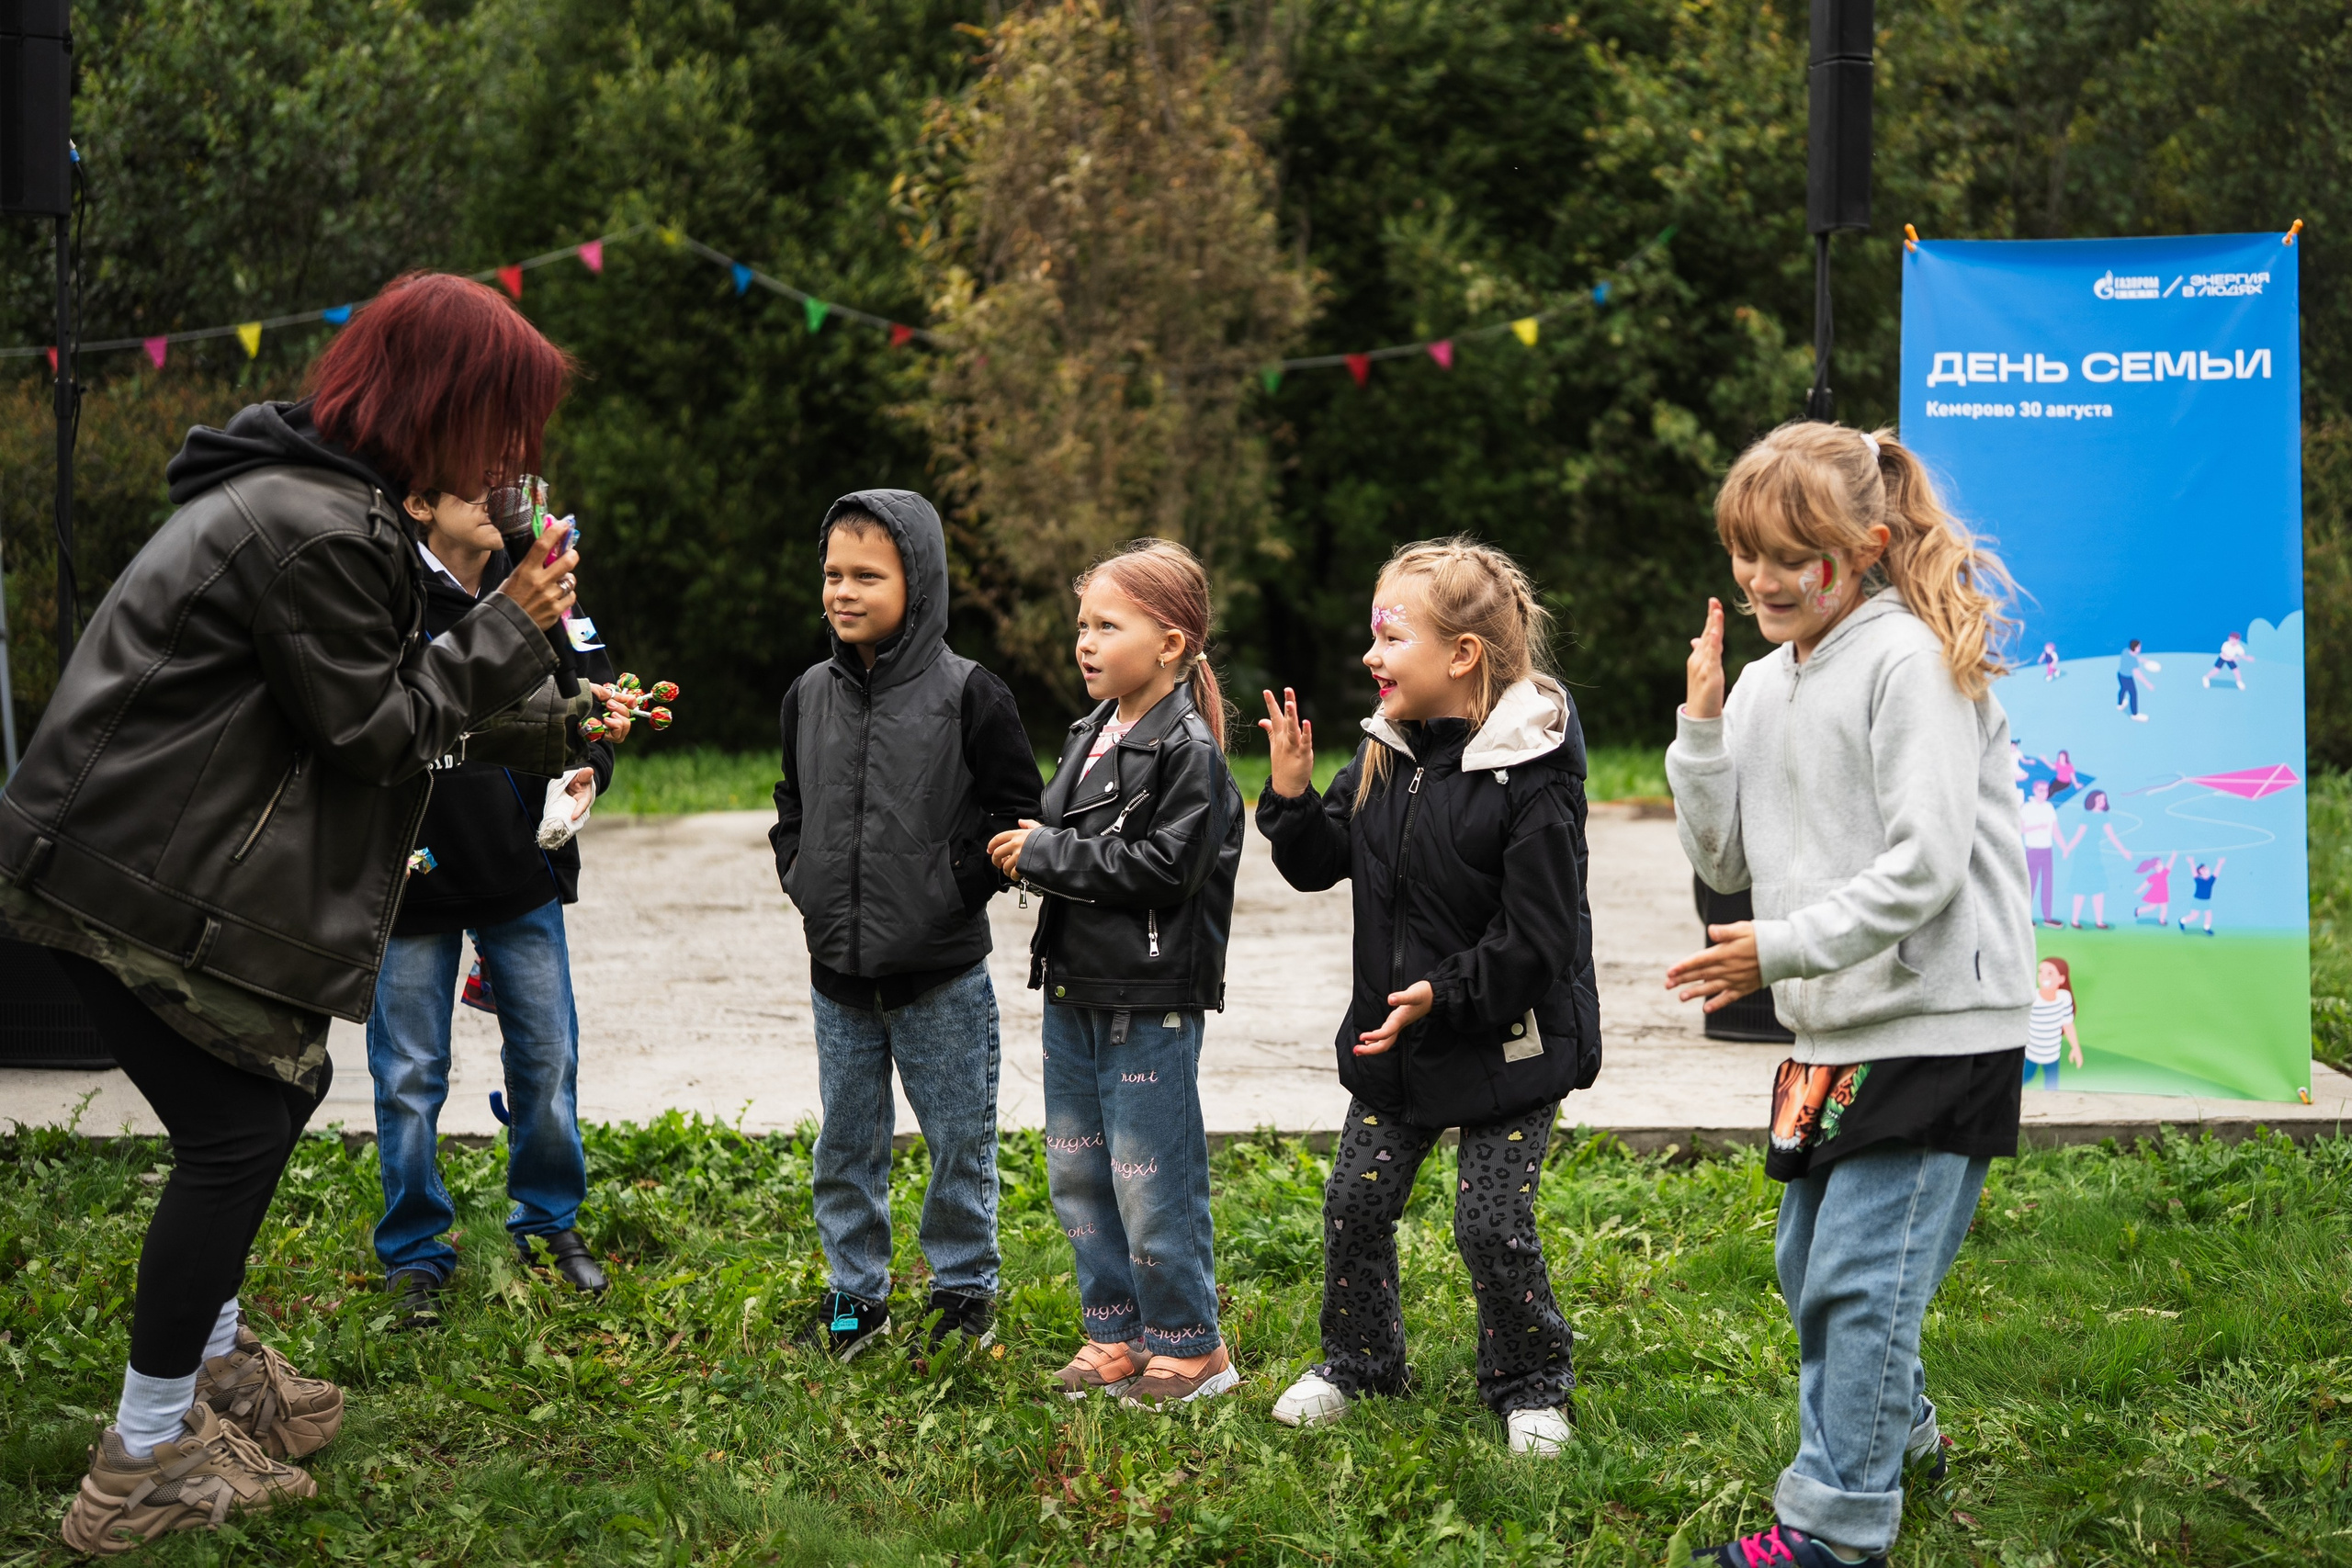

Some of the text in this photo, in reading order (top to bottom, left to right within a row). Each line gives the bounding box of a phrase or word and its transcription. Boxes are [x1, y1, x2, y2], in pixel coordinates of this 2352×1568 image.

[2189, 272, 2270, 287] ЭНЕРГИЯ
[2182, 284, 2263, 298] В ЛЮДЯХ
[1927, 348, 2272, 388] ДЕНЬ СЕМЬИ
[1926, 400, 2112, 421] Кемерово 30 августа
[1046, 1132, 1103, 1154] engxi
[1068, 1222, 1096, 1238] ont
[1081, 1298, 1134, 1321] ngxi
